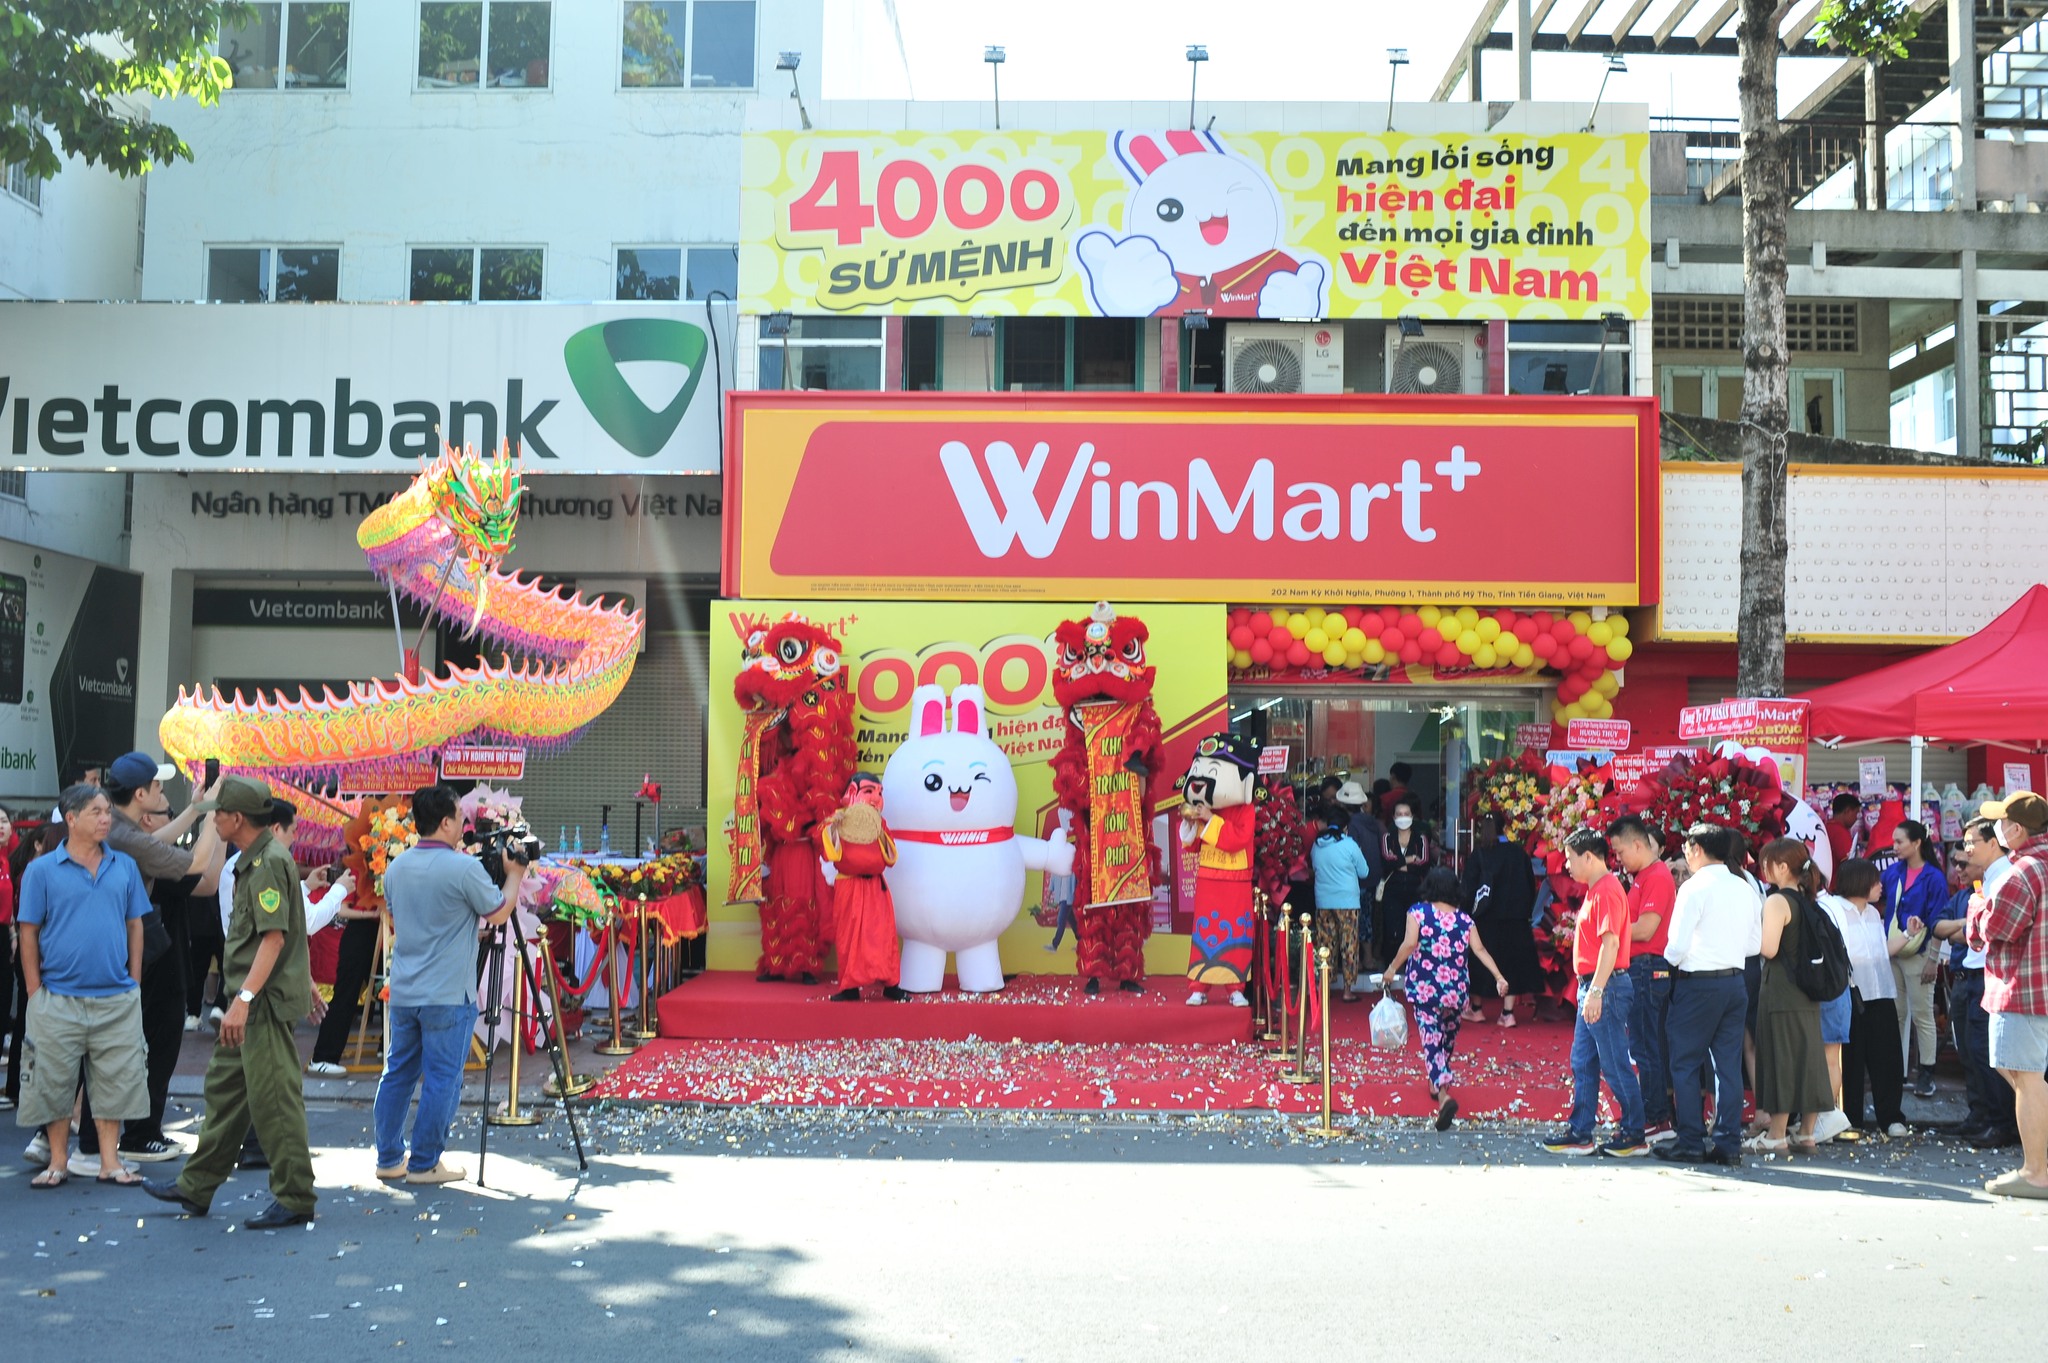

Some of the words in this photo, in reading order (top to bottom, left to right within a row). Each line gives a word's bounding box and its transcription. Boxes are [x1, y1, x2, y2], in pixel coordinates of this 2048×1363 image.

[1336, 156, 1424, 178] Mang
[1431, 144, 1469, 170] lối
[1476, 139, 1554, 170] sống
[789, 150, 1060, 246] 4000
[1336, 182, 1434, 219] hiện
[1444, 174, 1515, 218] đại
[1338, 218, 1397, 242] đến
[1404, 221, 1463, 248] mọi
[1470, 221, 1519, 250] gia
[1526, 221, 1593, 246] đình
[828, 249, 906, 295] SỨ
[906, 237, 1054, 288] MỆNH
[1340, 250, 1457, 297] Việt
[1469, 257, 1598, 302] Nam
[1316, 350, 1330, 358] LG
[0, 375, 560, 459] ietcombank
[191, 490, 261, 518] Ngân
[268, 491, 333, 519] hàng
[621, 493, 677, 520] Việt
[685, 494, 722, 516] Na
[250, 599, 386, 619] Vietcombank
[1271, 588, 1287, 596] 202
[1290, 588, 1308, 596] Nam
[1311, 588, 1322, 598] Kỳ
[1324, 588, 1342, 597] Khởi
[1345, 588, 1372, 599] Nghĩa,
[1375, 588, 1406, 599] Phường
[1417, 588, 1442, 598] Thành
[1445, 589, 1460, 599] phố
[1463, 590, 1475, 600] Mỹ
[1478, 591, 1495, 600] Tho,
[1498, 590, 1515, 599] Tỉnh
[1518, 590, 1536, 599] Tiền
[1538, 590, 1565, 601] Giang,
[1567, 591, 1584, 600] Việt
[79, 675, 132, 698] Vietcombank
[838, 644, 1047, 714] 000
[997, 720, 1038, 739] hiện
[1042, 715, 1067, 733] đạ
[1757, 708, 1804, 721] nMart+
[1038, 736, 1068, 750] Na
[940, 831, 990, 845] WINNIE
